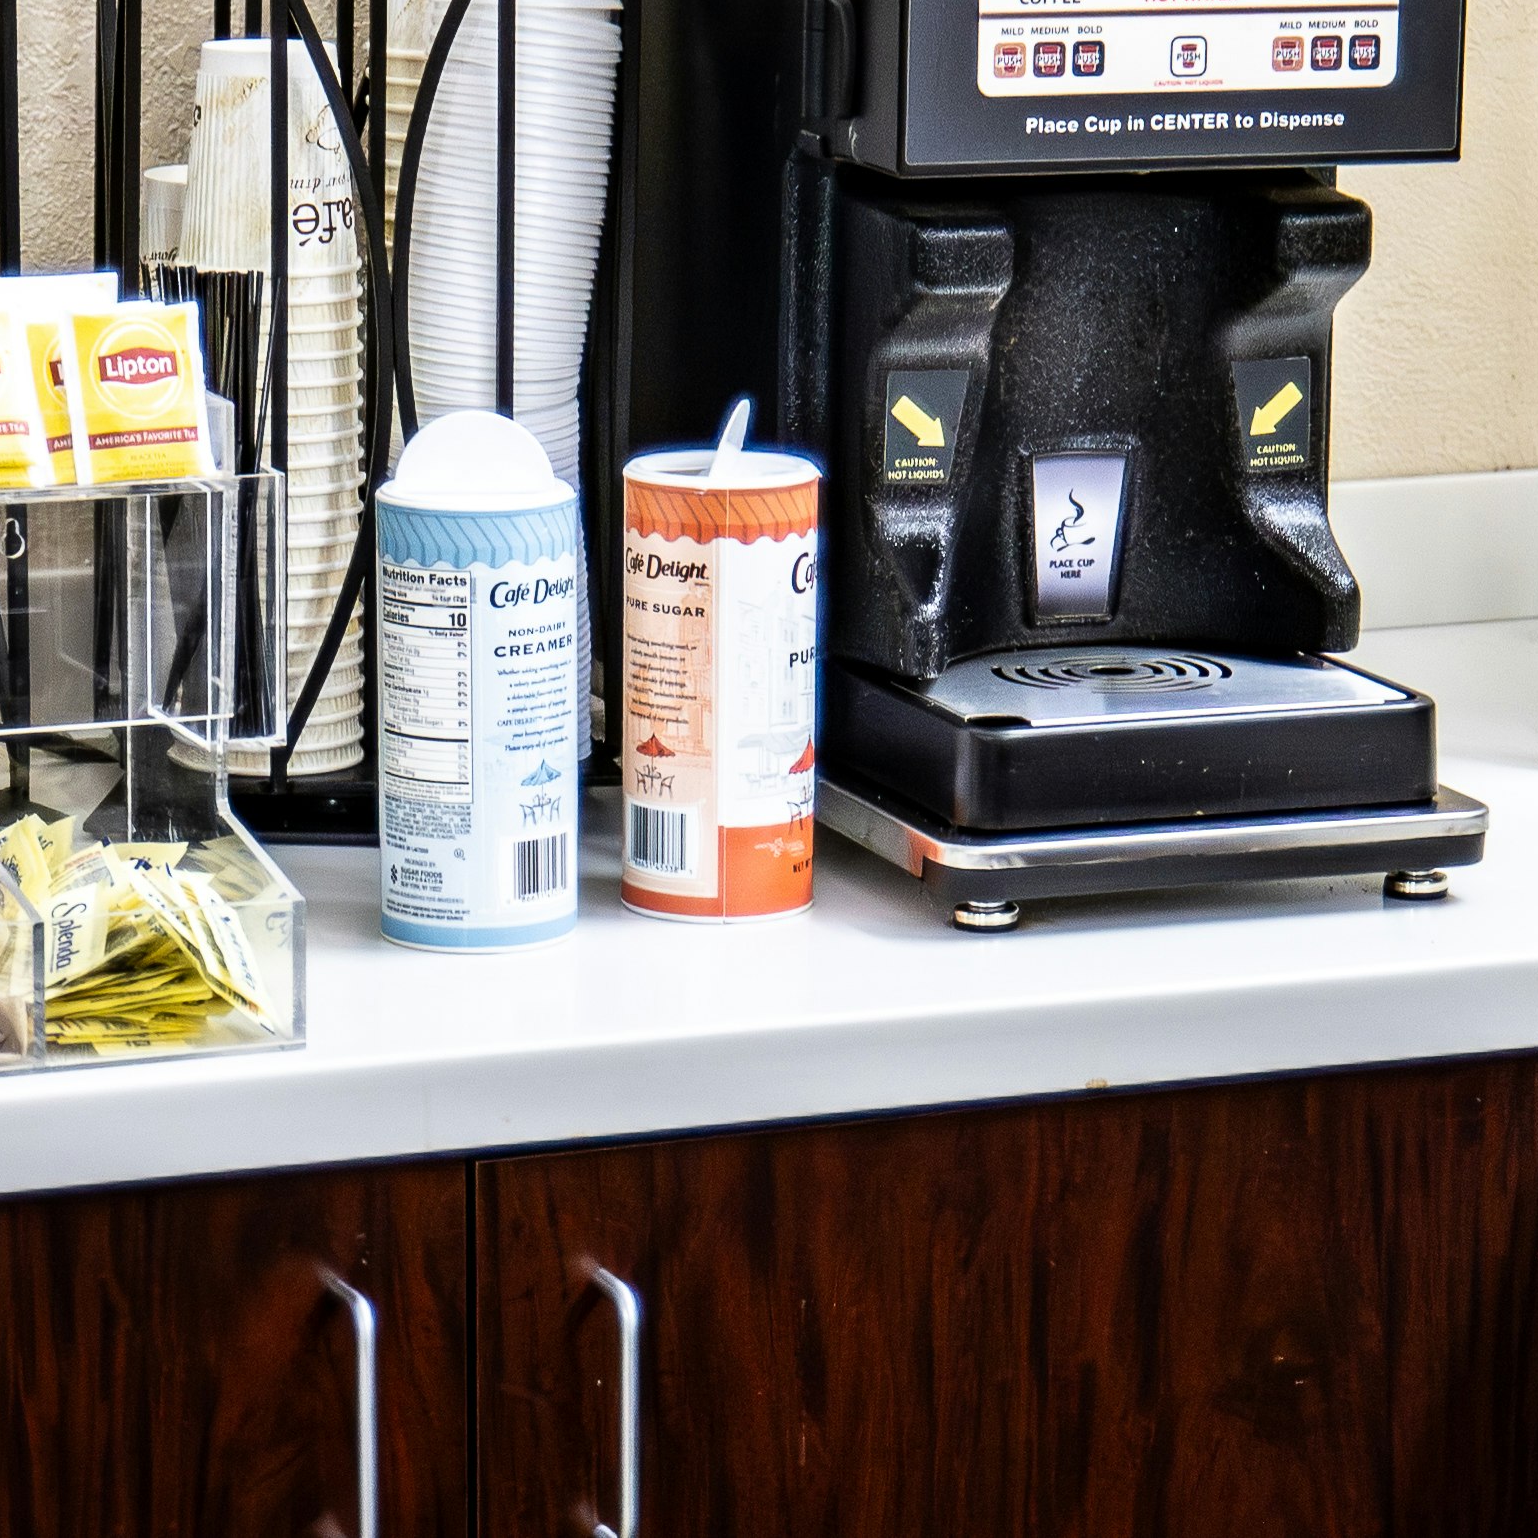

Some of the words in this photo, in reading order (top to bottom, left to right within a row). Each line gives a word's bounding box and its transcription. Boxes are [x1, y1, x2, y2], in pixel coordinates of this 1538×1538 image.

[1000, 27, 1025, 36] MILD
[1030, 26, 1070, 35] MEDIUM
[1077, 25, 1103, 34] BOLD
[1279, 20, 1303, 30] MILD
[1308, 20, 1346, 29] MEDIUM
[1354, 19, 1379, 28] BOLD
[1037, 54, 1062, 64] PUSH
[1075, 53, 1101, 63] PUSH
[1176, 51, 1201, 61] PUSH
[1276, 49, 1300, 59] PUSH
[1314, 48, 1338, 58] PUSH
[1352, 48, 1376, 58] PUSH
[997, 56, 1023, 66] PUSH
[1025, 116, 1079, 135] Place
[1085, 115, 1121, 135] Cup
[1127, 114, 1145, 131] in
[1150, 112, 1229, 131] CENTER
[1235, 113, 1253, 129] to
[1259, 111, 1345, 131] Dispense
[105, 355, 173, 380] Lipton
[9, 422, 26, 433] TEA
[95, 433, 143, 446] AMERICA'S
[143, 430, 182, 443] FAVORITE
[1250, 456, 1268, 467] HOT
[1269, 454, 1305, 466] LIQUIDS
[887, 469, 907, 480] HOT
[908, 468, 945, 480] LIQUIDS
[625, 547, 645, 575] Café
[1049, 559, 1074, 569] PLACE
[1077, 558, 1095, 567] CUP
[382, 564, 425, 584] Nutrition
[428, 573, 468, 587] Facts
[1060, 569, 1082, 579] HERE
[489, 581, 530, 609] Café
[625, 595, 648, 611] PURE
[652, 603, 705, 618] SUGAR
[448, 612, 467, 628] 10
[508, 621, 566, 638] NON-DAIRY
[493, 633, 573, 658] CREAMER
[789, 646, 815, 668] PUR
[51, 902, 87, 970] Splenda
